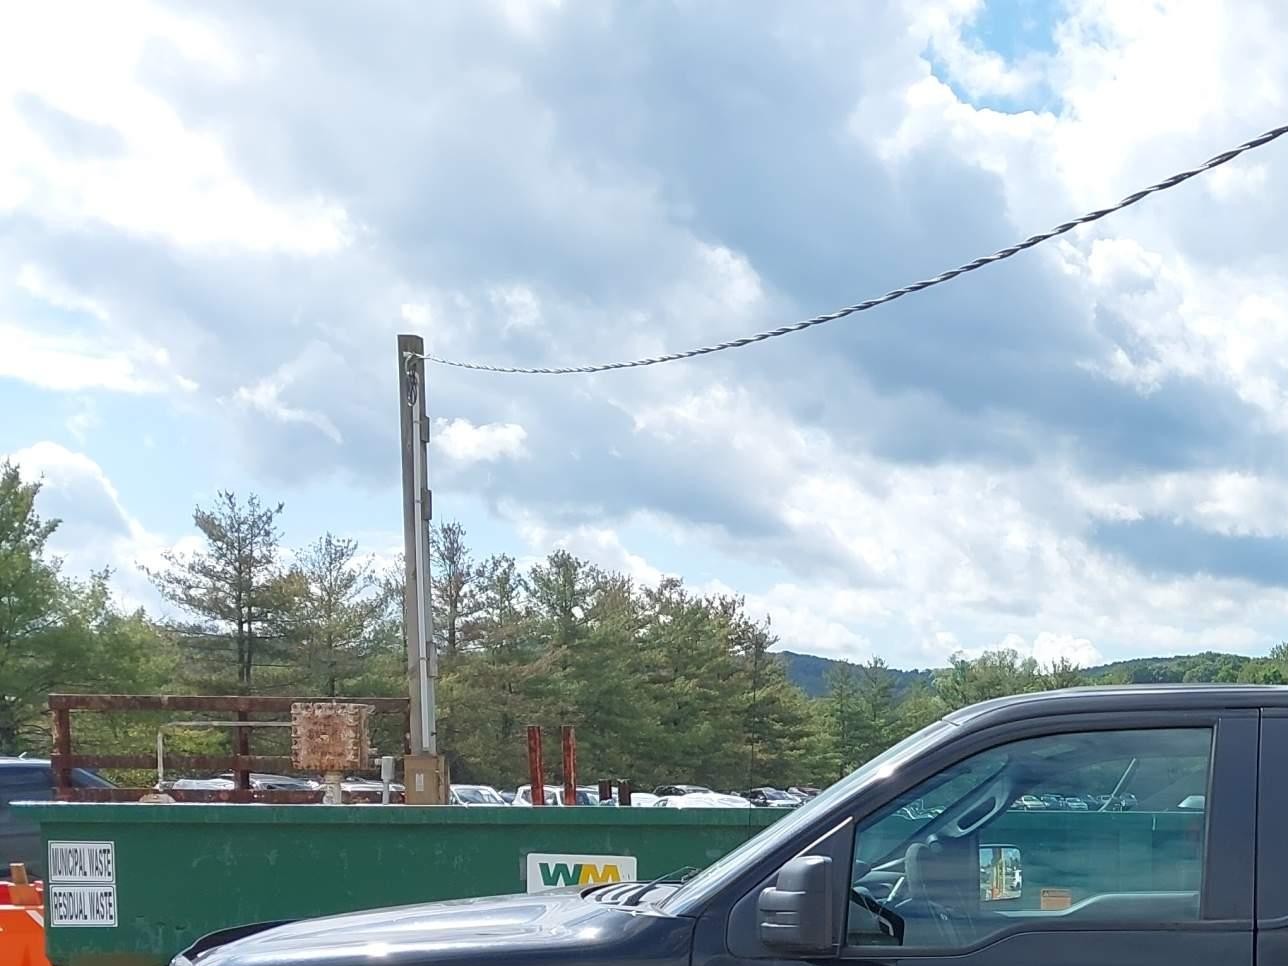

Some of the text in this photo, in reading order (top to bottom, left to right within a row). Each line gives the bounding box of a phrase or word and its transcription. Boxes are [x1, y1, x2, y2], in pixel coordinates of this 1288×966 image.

[51, 847, 112, 877] MUNICIPAL WASTE
[538, 862, 621, 887] WM
[53, 891, 114, 920] RESIDUAL WASTE
